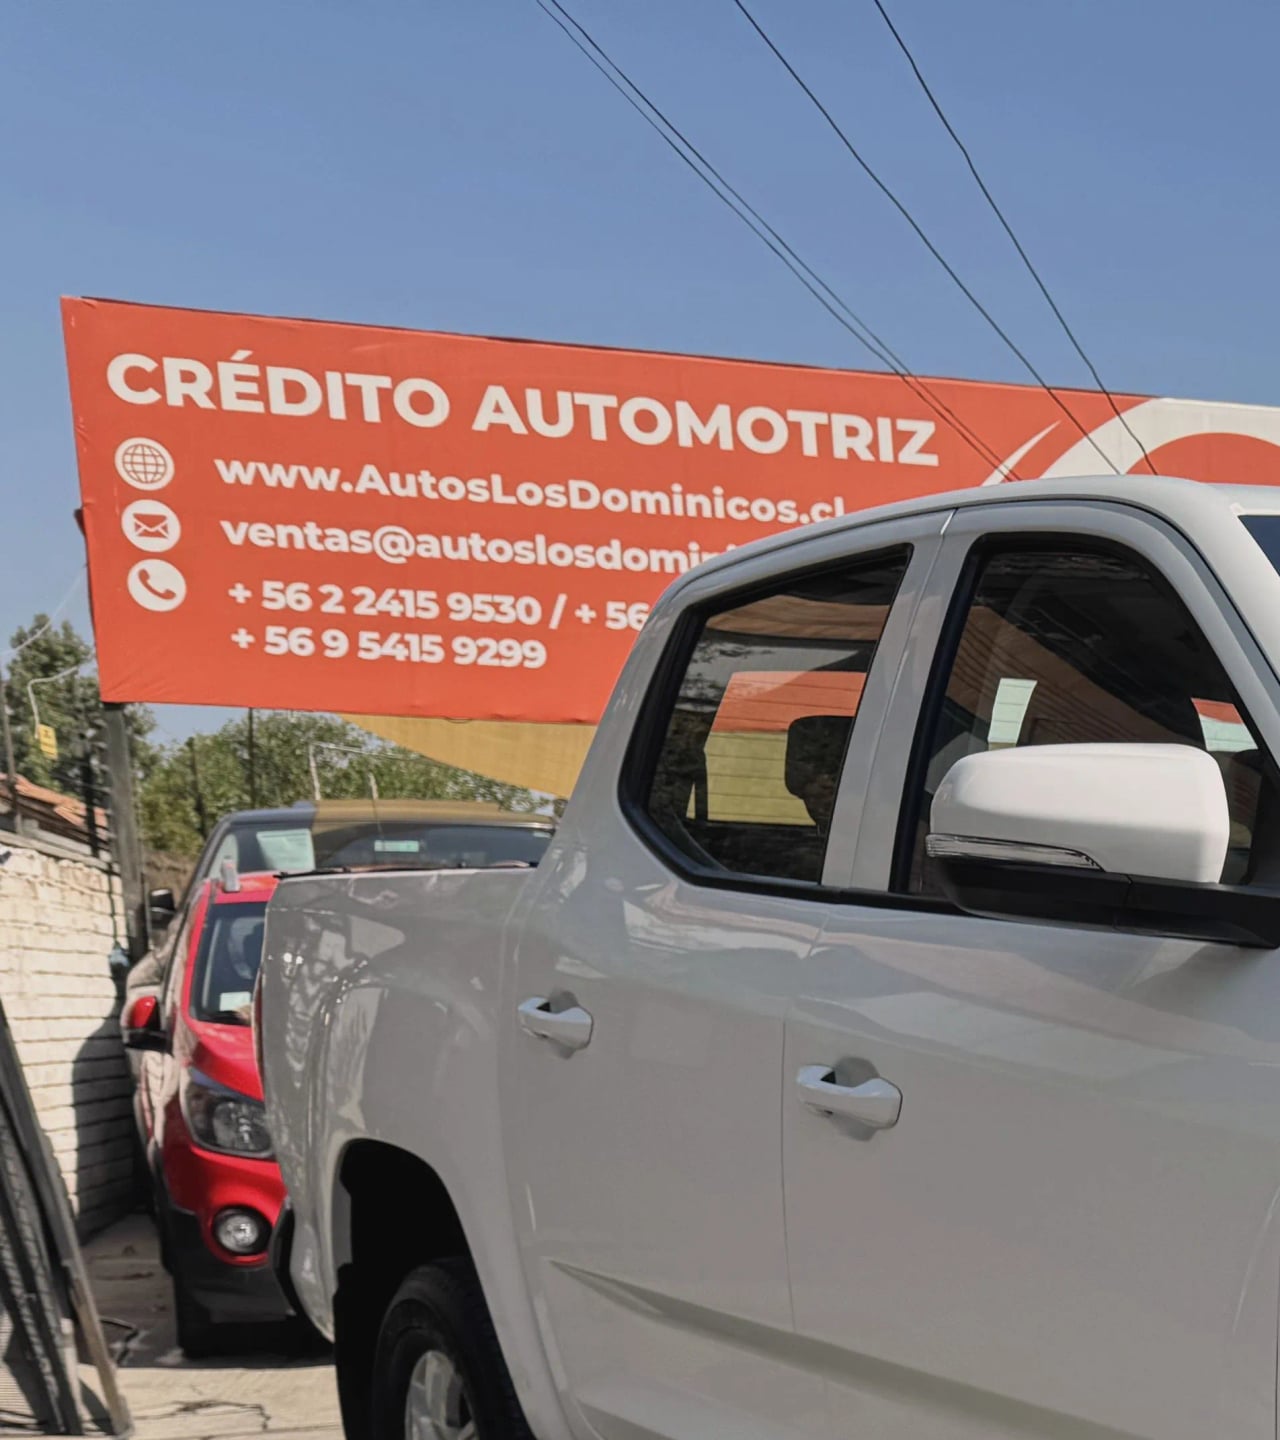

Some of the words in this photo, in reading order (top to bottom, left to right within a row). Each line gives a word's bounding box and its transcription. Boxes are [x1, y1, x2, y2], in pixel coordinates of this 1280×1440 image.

[107, 349, 450, 428] CRÉDITO
[471, 385, 940, 467] AUTOMOTRIZ
[213, 458, 845, 525] www.AutosLosDominicos.cl
[261, 579, 313, 612] 56
[317, 583, 347, 614] 2
[351, 585, 441, 619] 2415
[446, 591, 542, 625] 9530
[605, 600, 651, 632] 56
[264, 624, 315, 657] 56
[321, 628, 349, 658] 9
[357, 630, 445, 663] 5415
[451, 635, 547, 669] 9299
